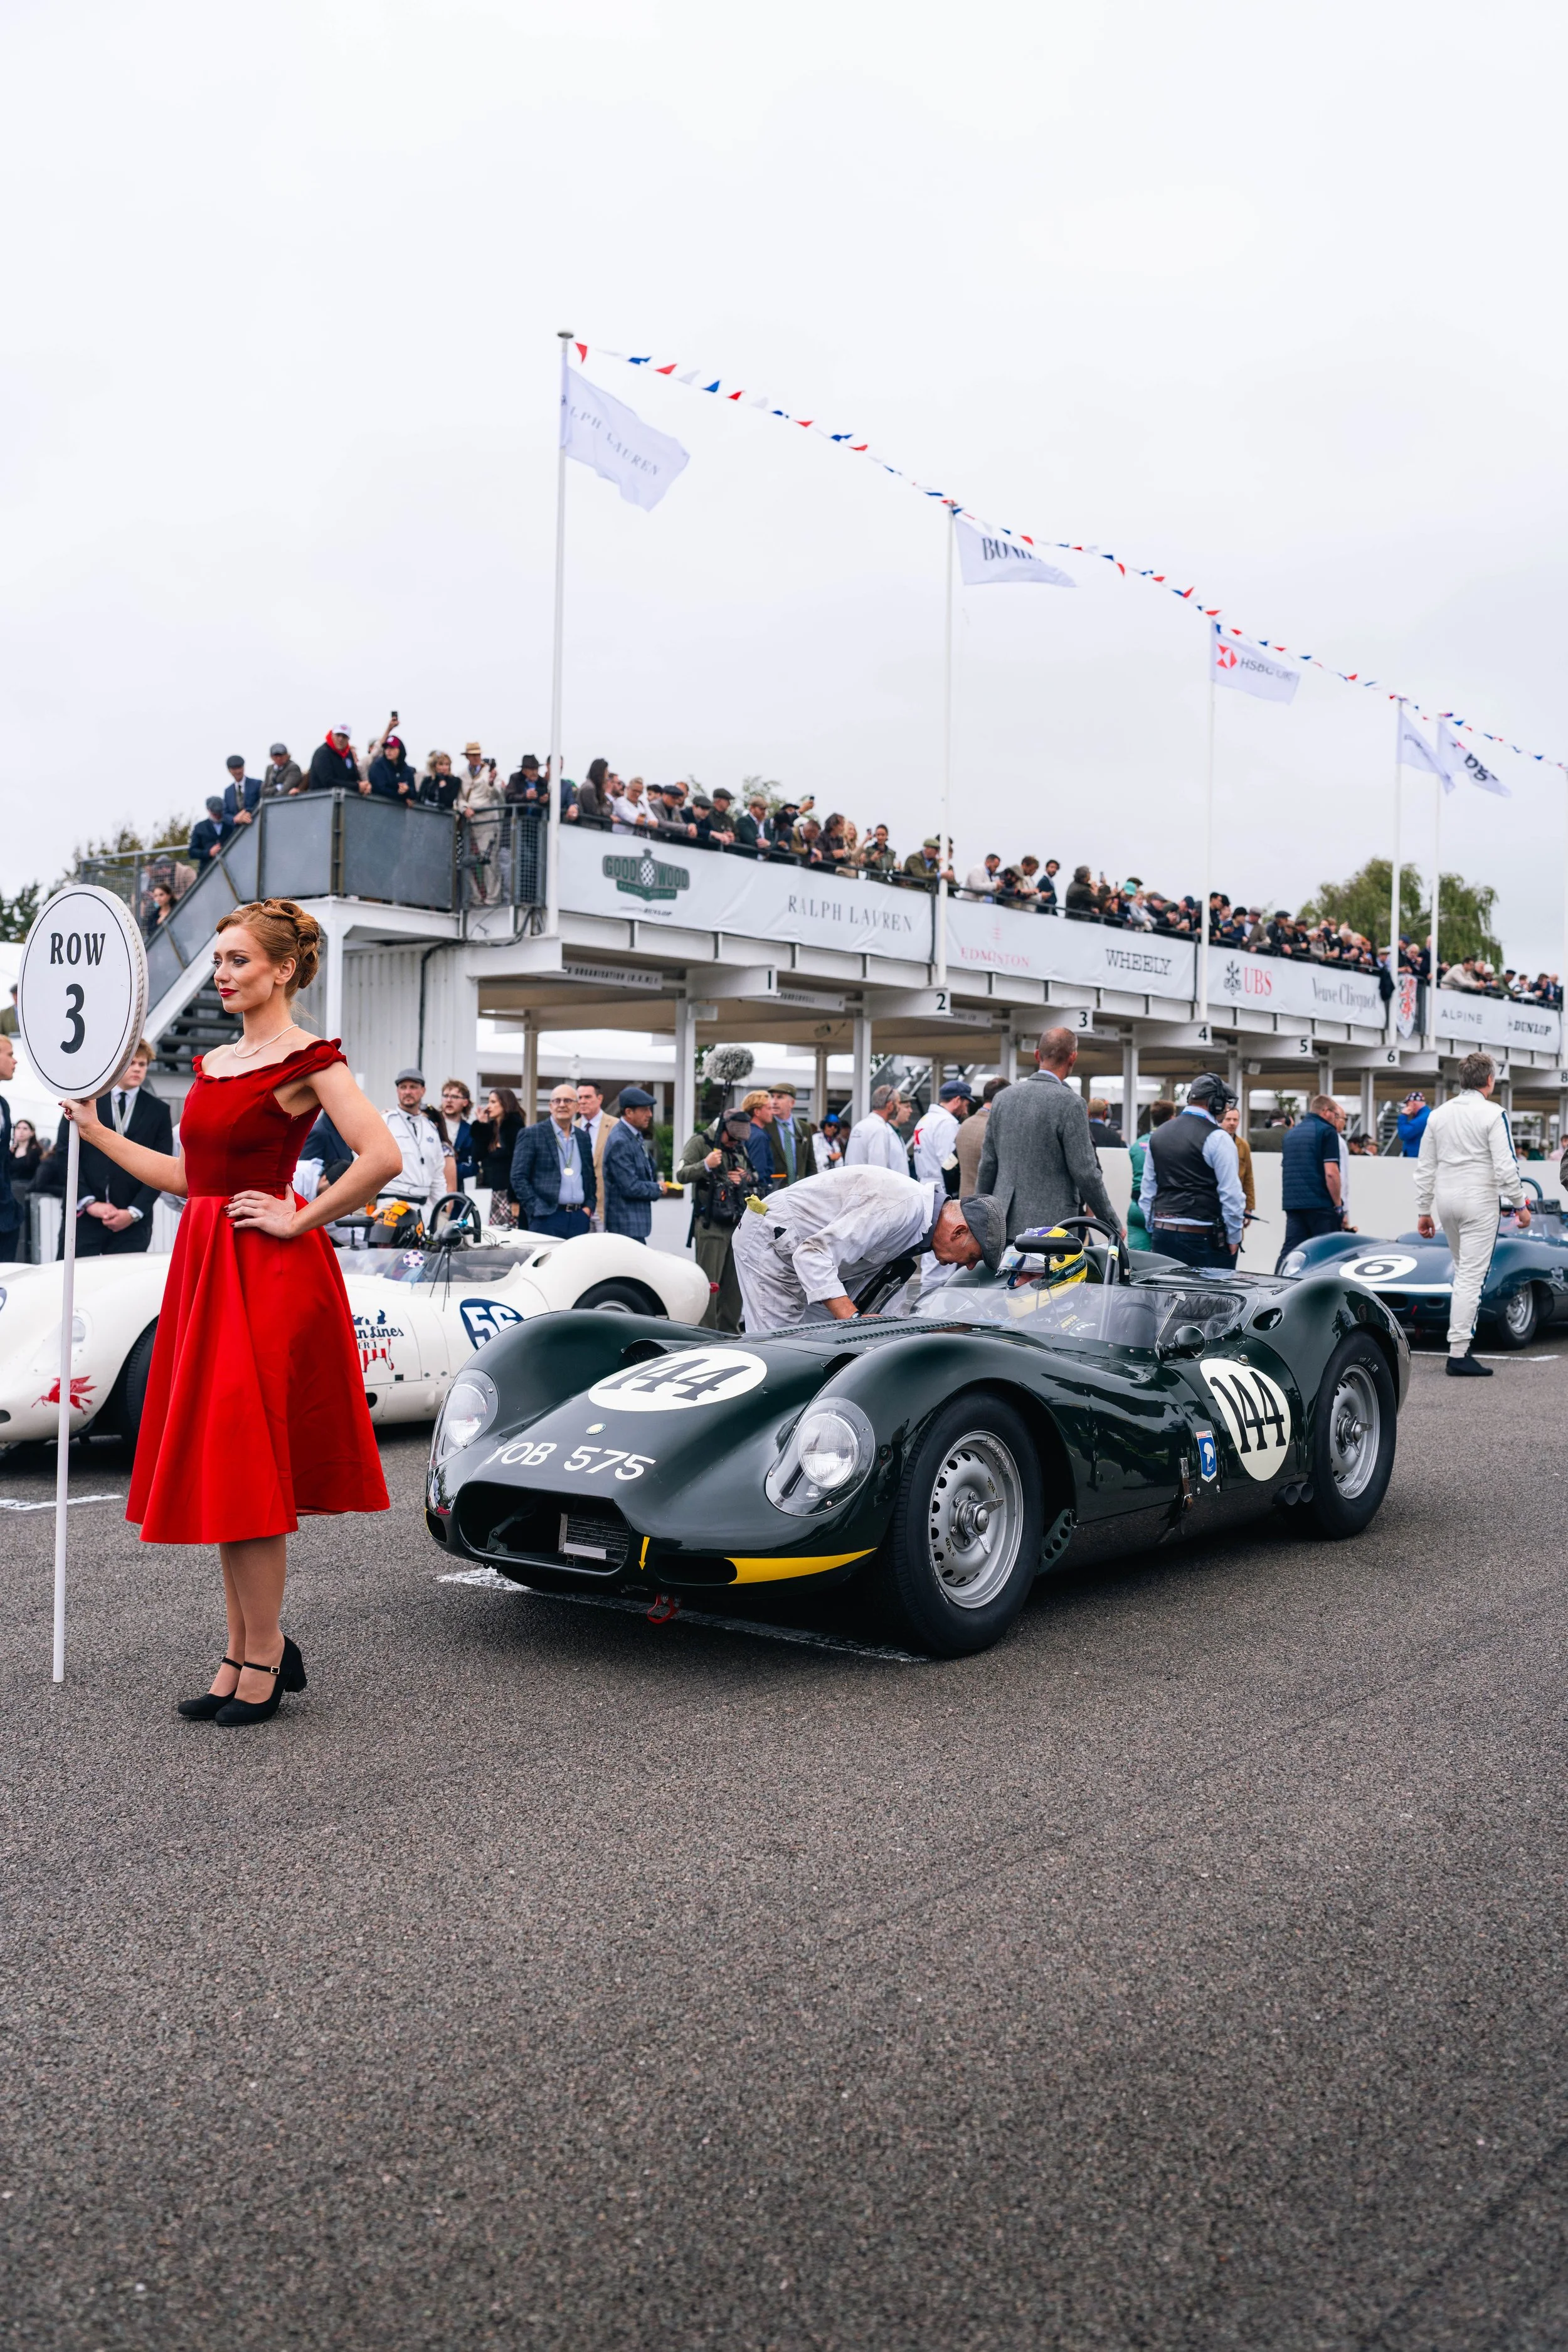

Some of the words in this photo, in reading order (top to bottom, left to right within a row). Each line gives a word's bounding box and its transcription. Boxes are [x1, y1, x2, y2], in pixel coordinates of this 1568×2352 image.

[788, 895, 841, 921] RALPH
[50, 933, 106, 965] ROW
[960, 947, 1029, 967] EDMISTON
[768, 970, 771, 989] 1
[1244, 967, 1272, 996] UBS
[936, 993, 946, 1010] 2
[1312, 977, 1338, 1002] Veuve
[1338, 982, 1377, 1012] Clicquot
[60, 983, 85, 1054] 3
[1079, 1012, 1087, 1027] 3
[1441, 1009, 1483, 1024] ALPINE
[1199, 1026, 1207, 1041] 4
[1514, 1020, 1552, 1036] DUNLOP
[1300, 1039, 1307, 1052] 5
[1387, 1050, 1396, 1062] 6
[1498, 1064, 1505, 1076] 7
[1560, 1071, 1568, 1083] 8
[1354, 1259, 1402, 1276] 6
[370, 1326, 404, 1338] Lines
[597, 1357, 752, 1401] 144
[1210, 1371, 1286, 1454] 144
[484, 1442, 558, 1466] YOB
[563, 1445, 657, 1480] 575
